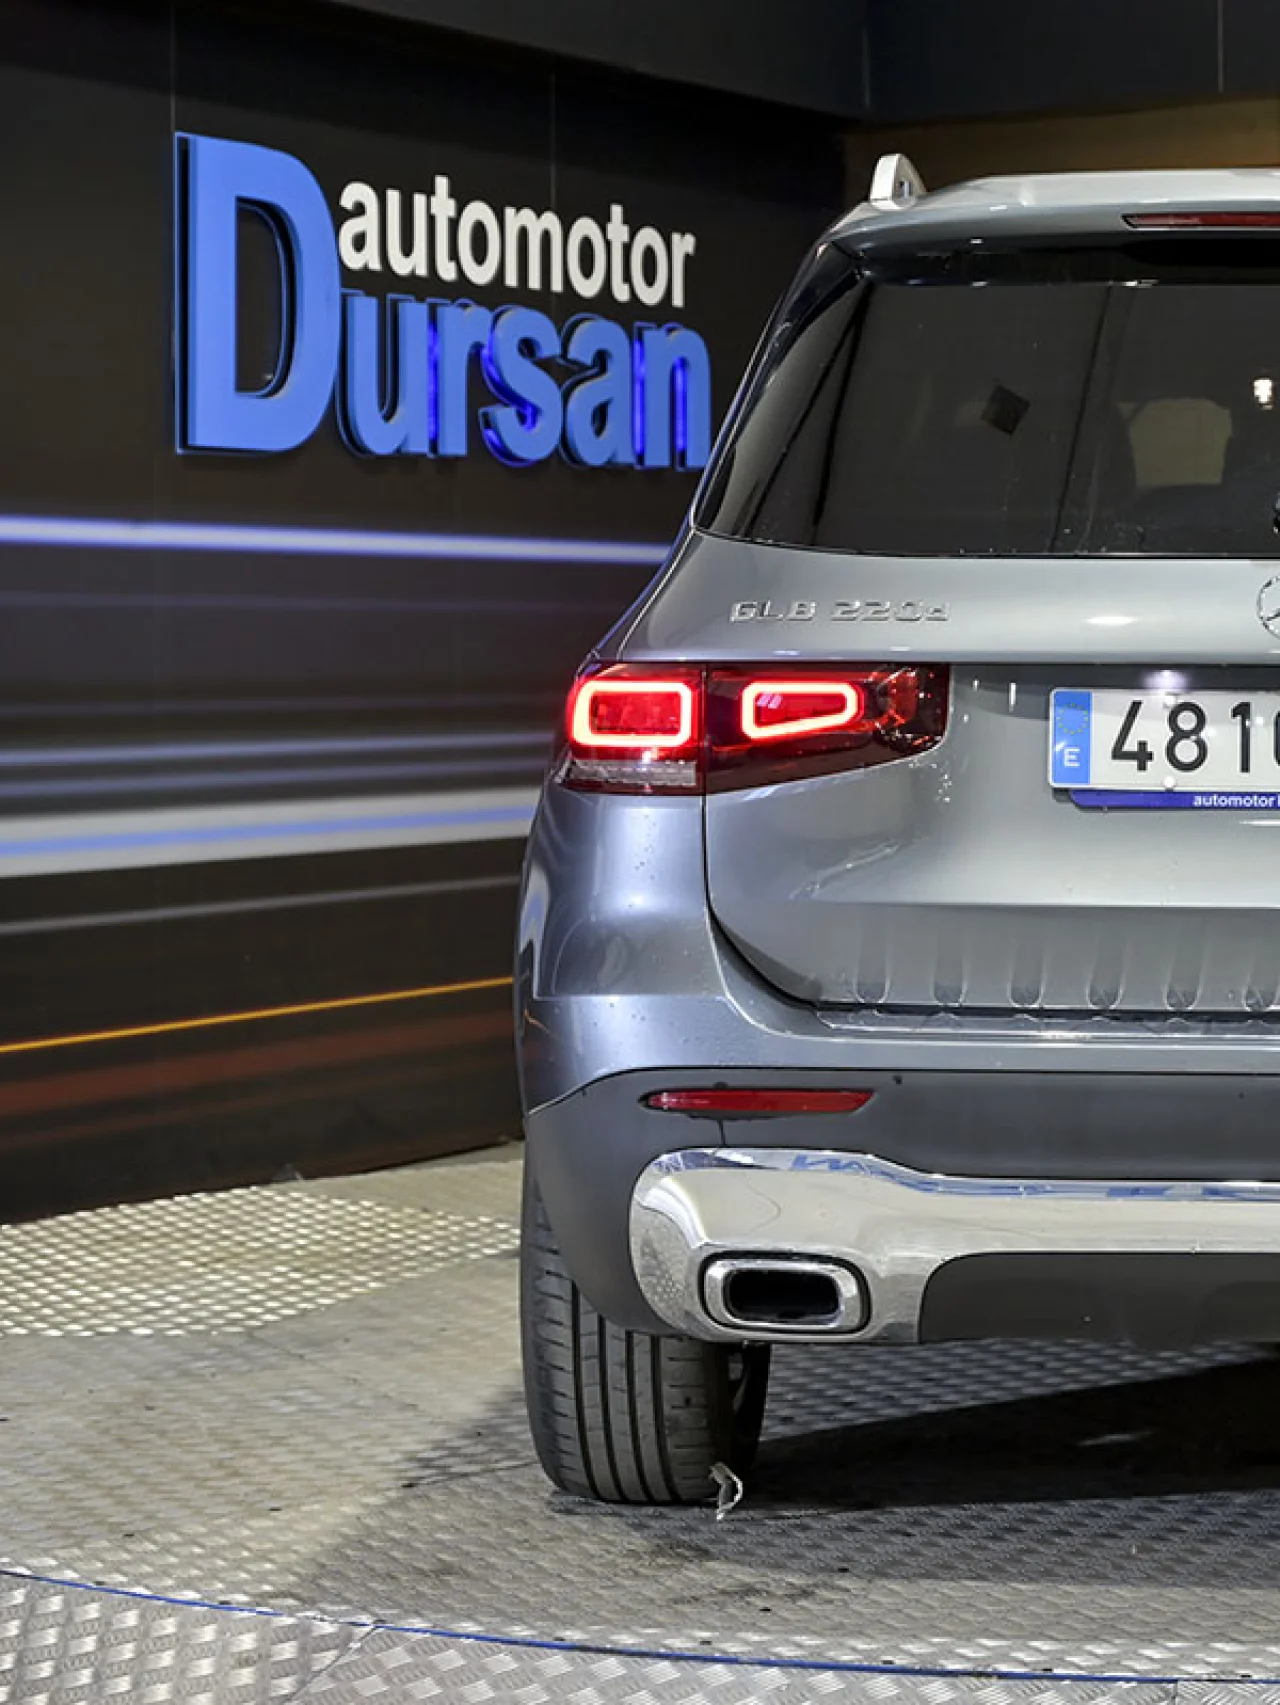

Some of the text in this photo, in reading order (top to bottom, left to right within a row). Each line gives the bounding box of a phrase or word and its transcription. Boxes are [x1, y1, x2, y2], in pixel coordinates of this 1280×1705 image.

[339, 174, 696, 308] automotor
[174, 131, 712, 472] Dursan
[730, 599, 949, 622] GLB 220d
[1063, 746, 1081, 768] E
[1193, 794, 1275, 808] automotor
